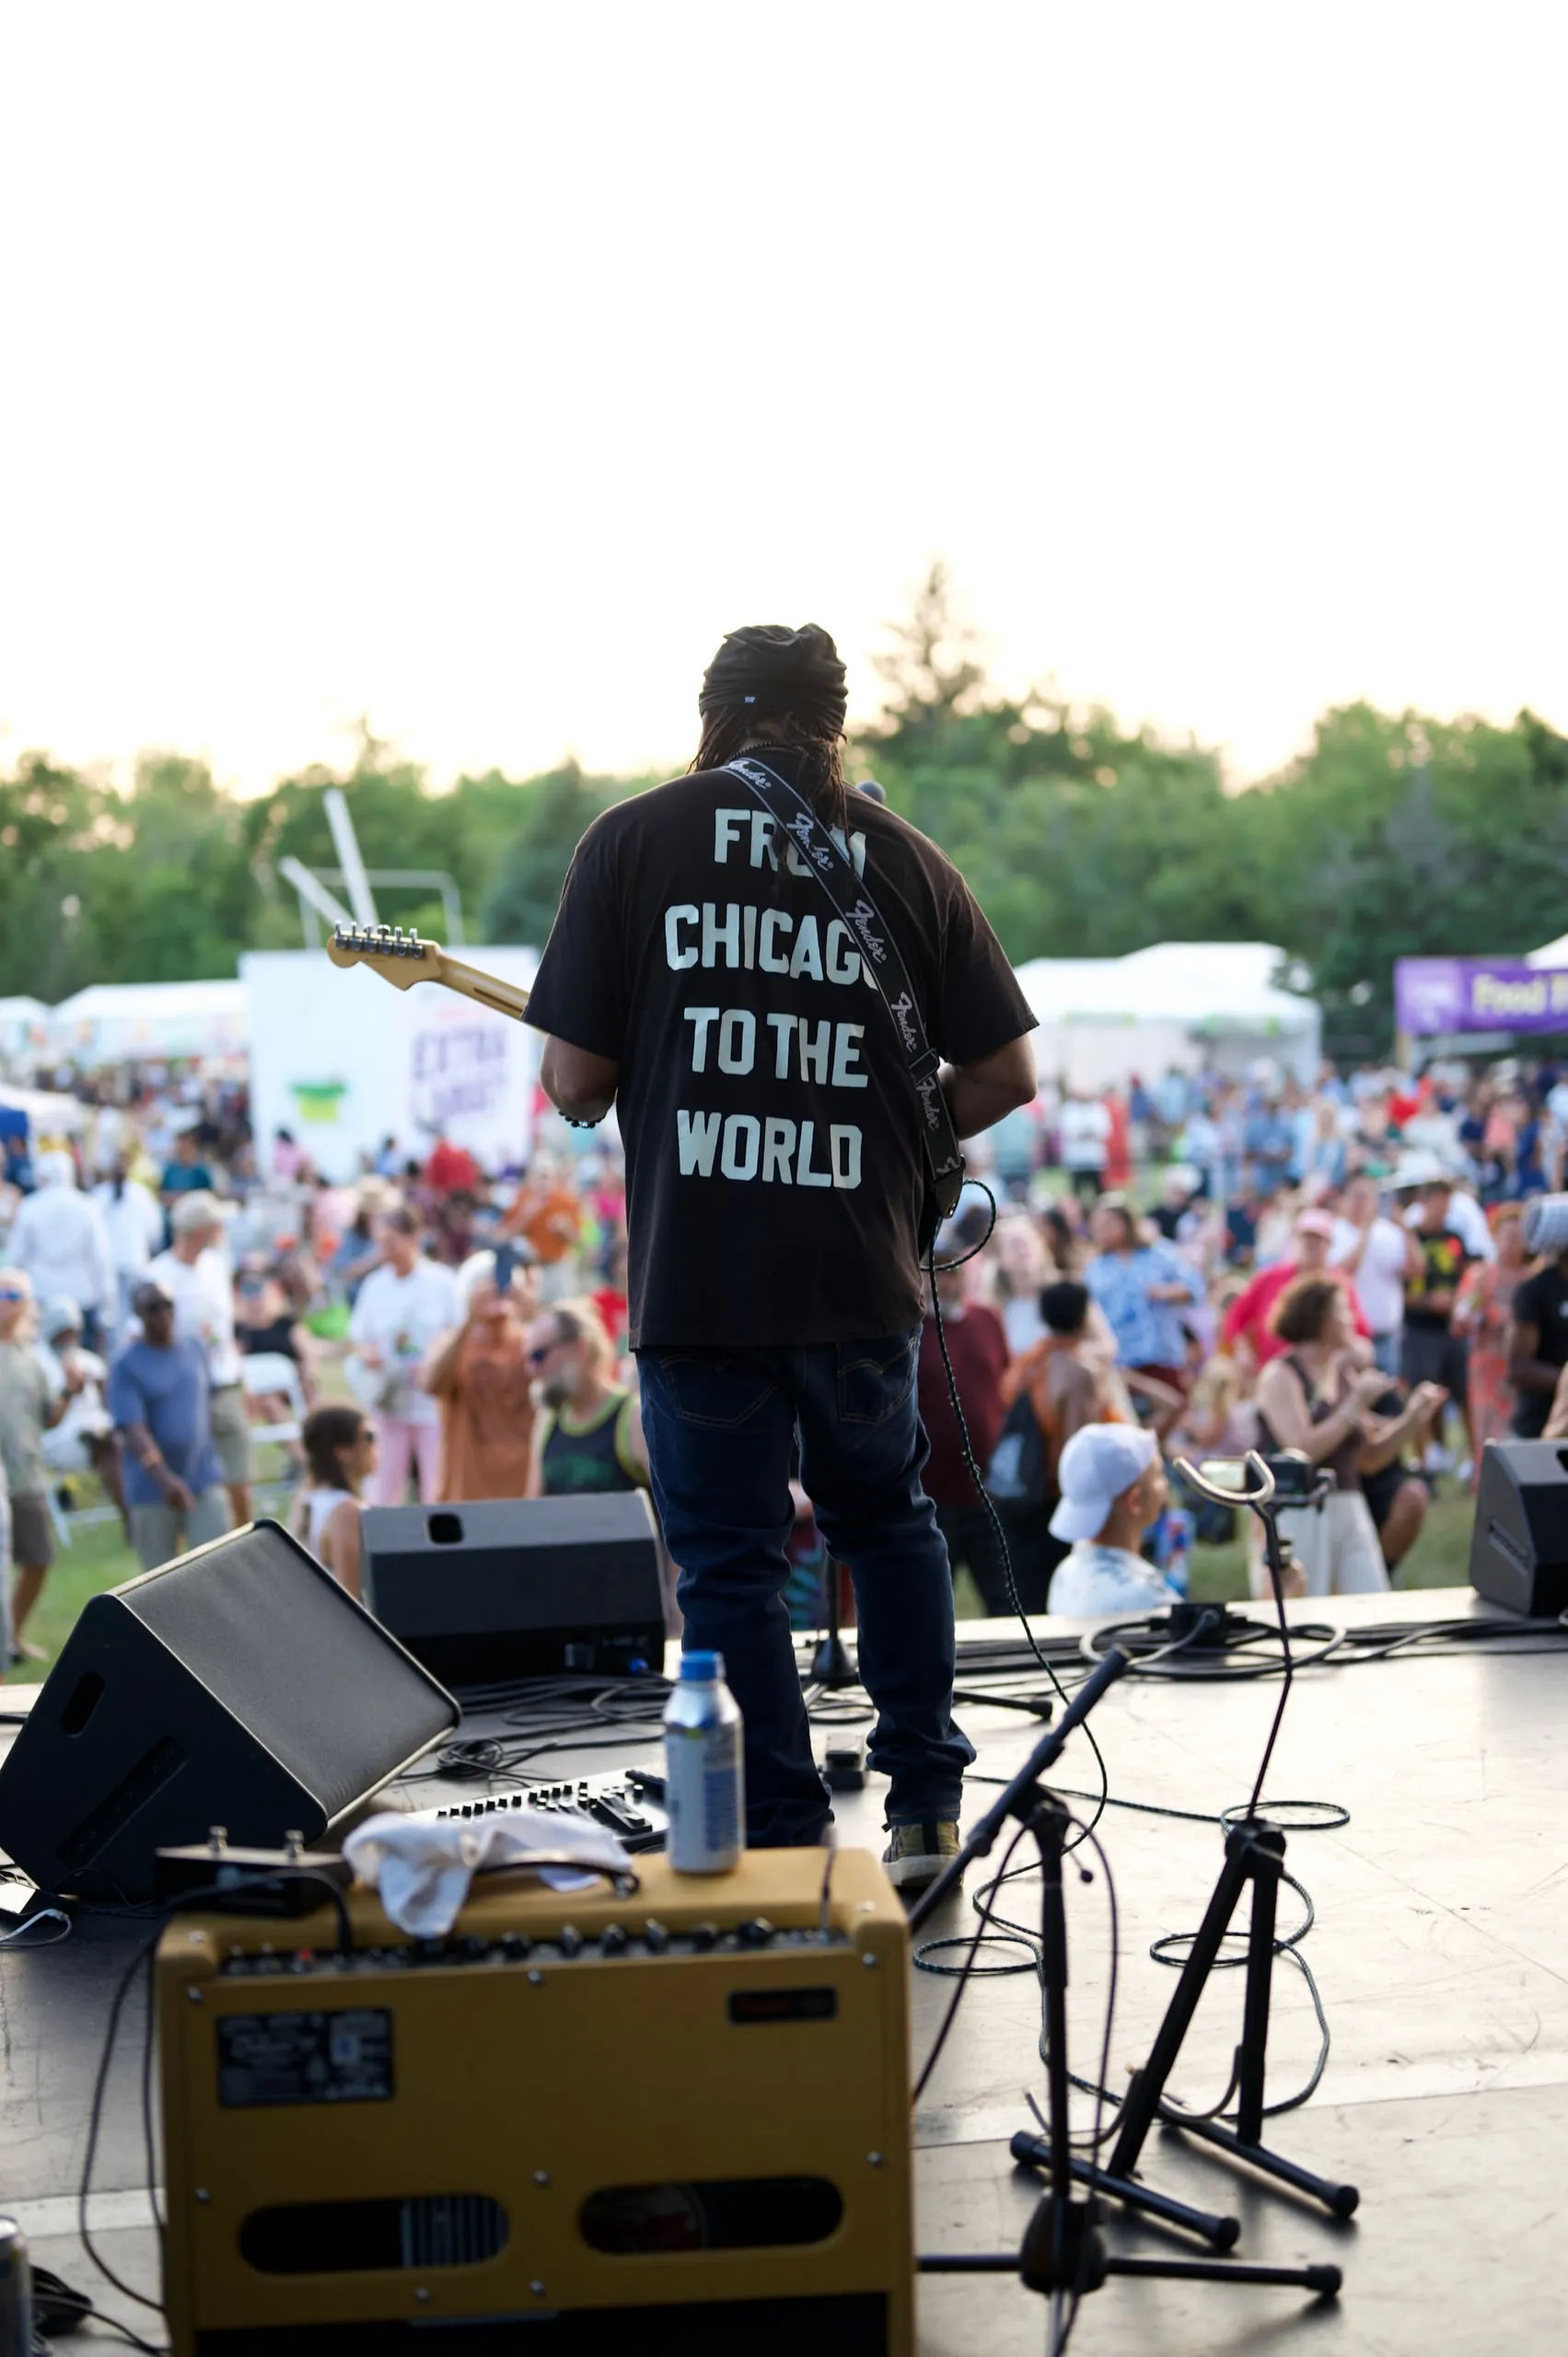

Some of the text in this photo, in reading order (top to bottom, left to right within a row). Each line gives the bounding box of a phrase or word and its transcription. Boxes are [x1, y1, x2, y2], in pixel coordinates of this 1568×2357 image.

[664, 902, 878, 991] CHICAG
[683, 1006, 868, 1088] TO THE
[677, 1109, 863, 1190] WORLD
